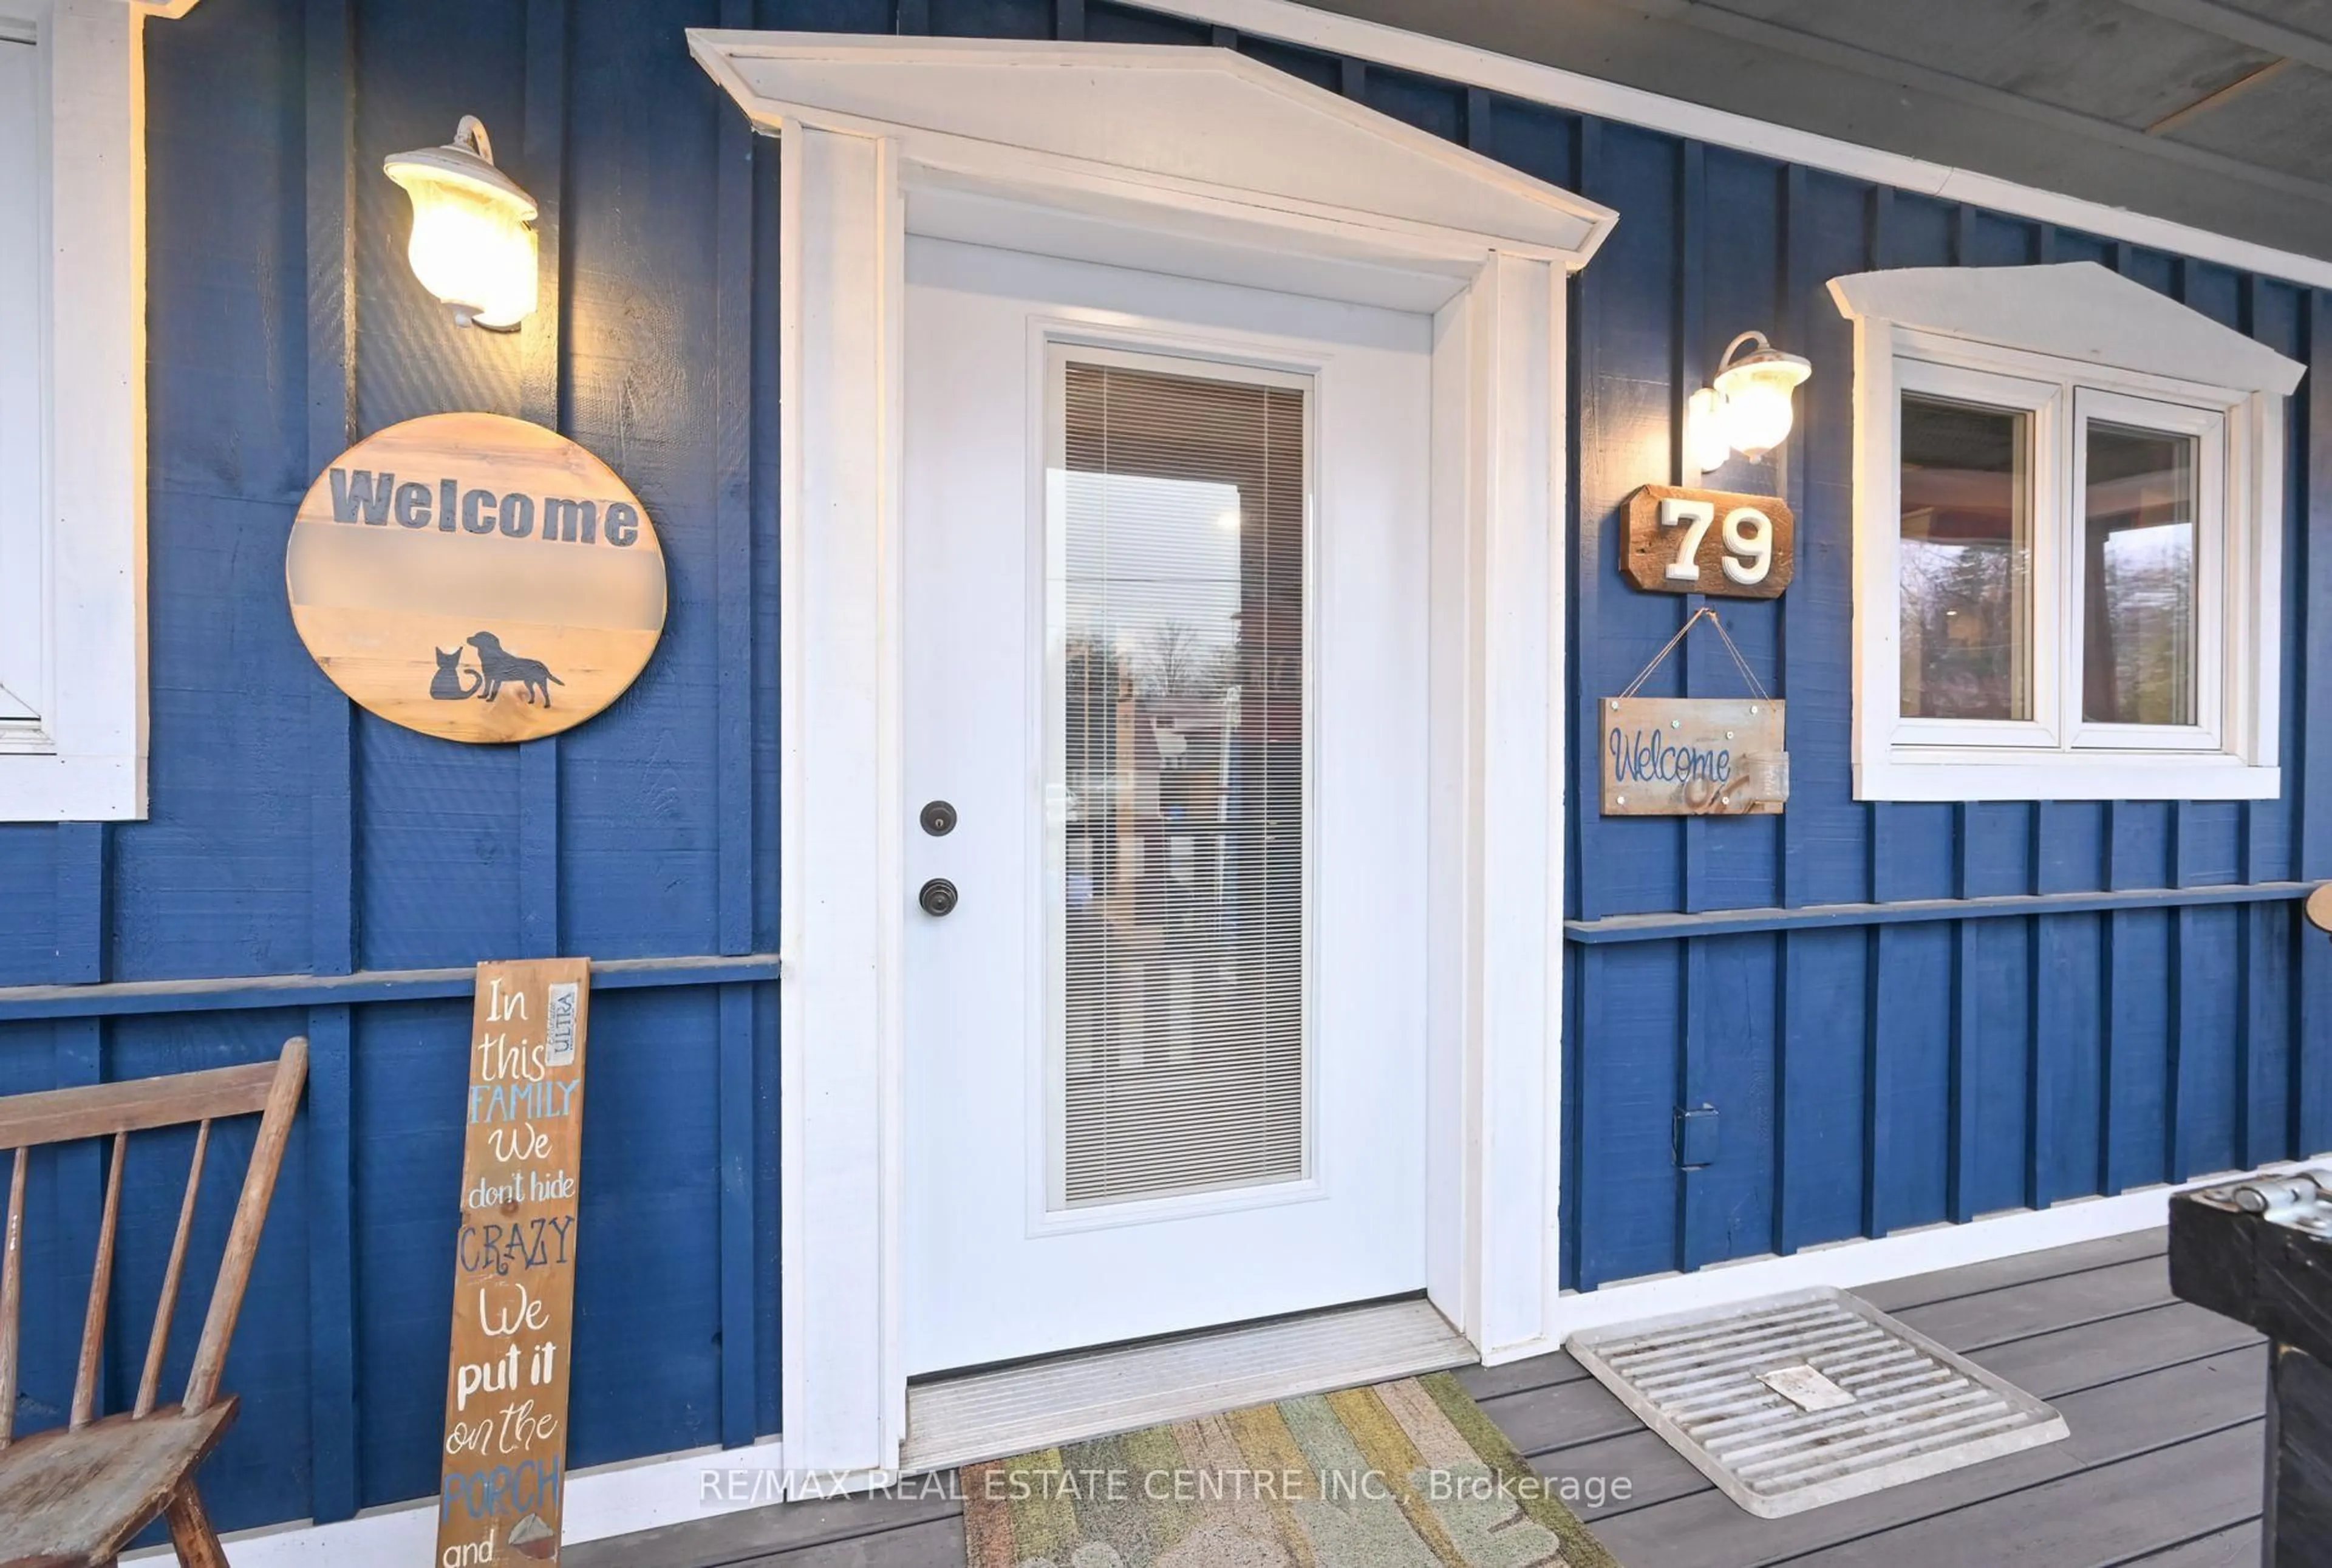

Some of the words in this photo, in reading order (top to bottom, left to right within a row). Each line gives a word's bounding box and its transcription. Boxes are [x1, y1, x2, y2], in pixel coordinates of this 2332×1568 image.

[329, 468, 639, 547] Welcome
[1662, 497, 1773, 585] 79
[1609, 727, 1730, 782] Welcome
[486, 978, 528, 1022] In
[554, 993, 572, 1053] ULTRA
[477, 1033, 545, 1082] this
[469, 1079, 581, 1123] FAMILY
[488, 1122, 553, 1162] We
[469, 1171, 525, 1209] don't
[530, 1169, 576, 1202] hide
[460, 1215, 574, 1275] CRAZY
[479, 1283, 550, 1336] We
[457, 1343, 522, 1411] put
[530, 1341, 557, 1386] it
[446, 1418, 494, 1456] on
[499, 1399, 559, 1454] the
[443, 1456, 560, 1525] PORCH
[443, 1528, 494, 1568] and
